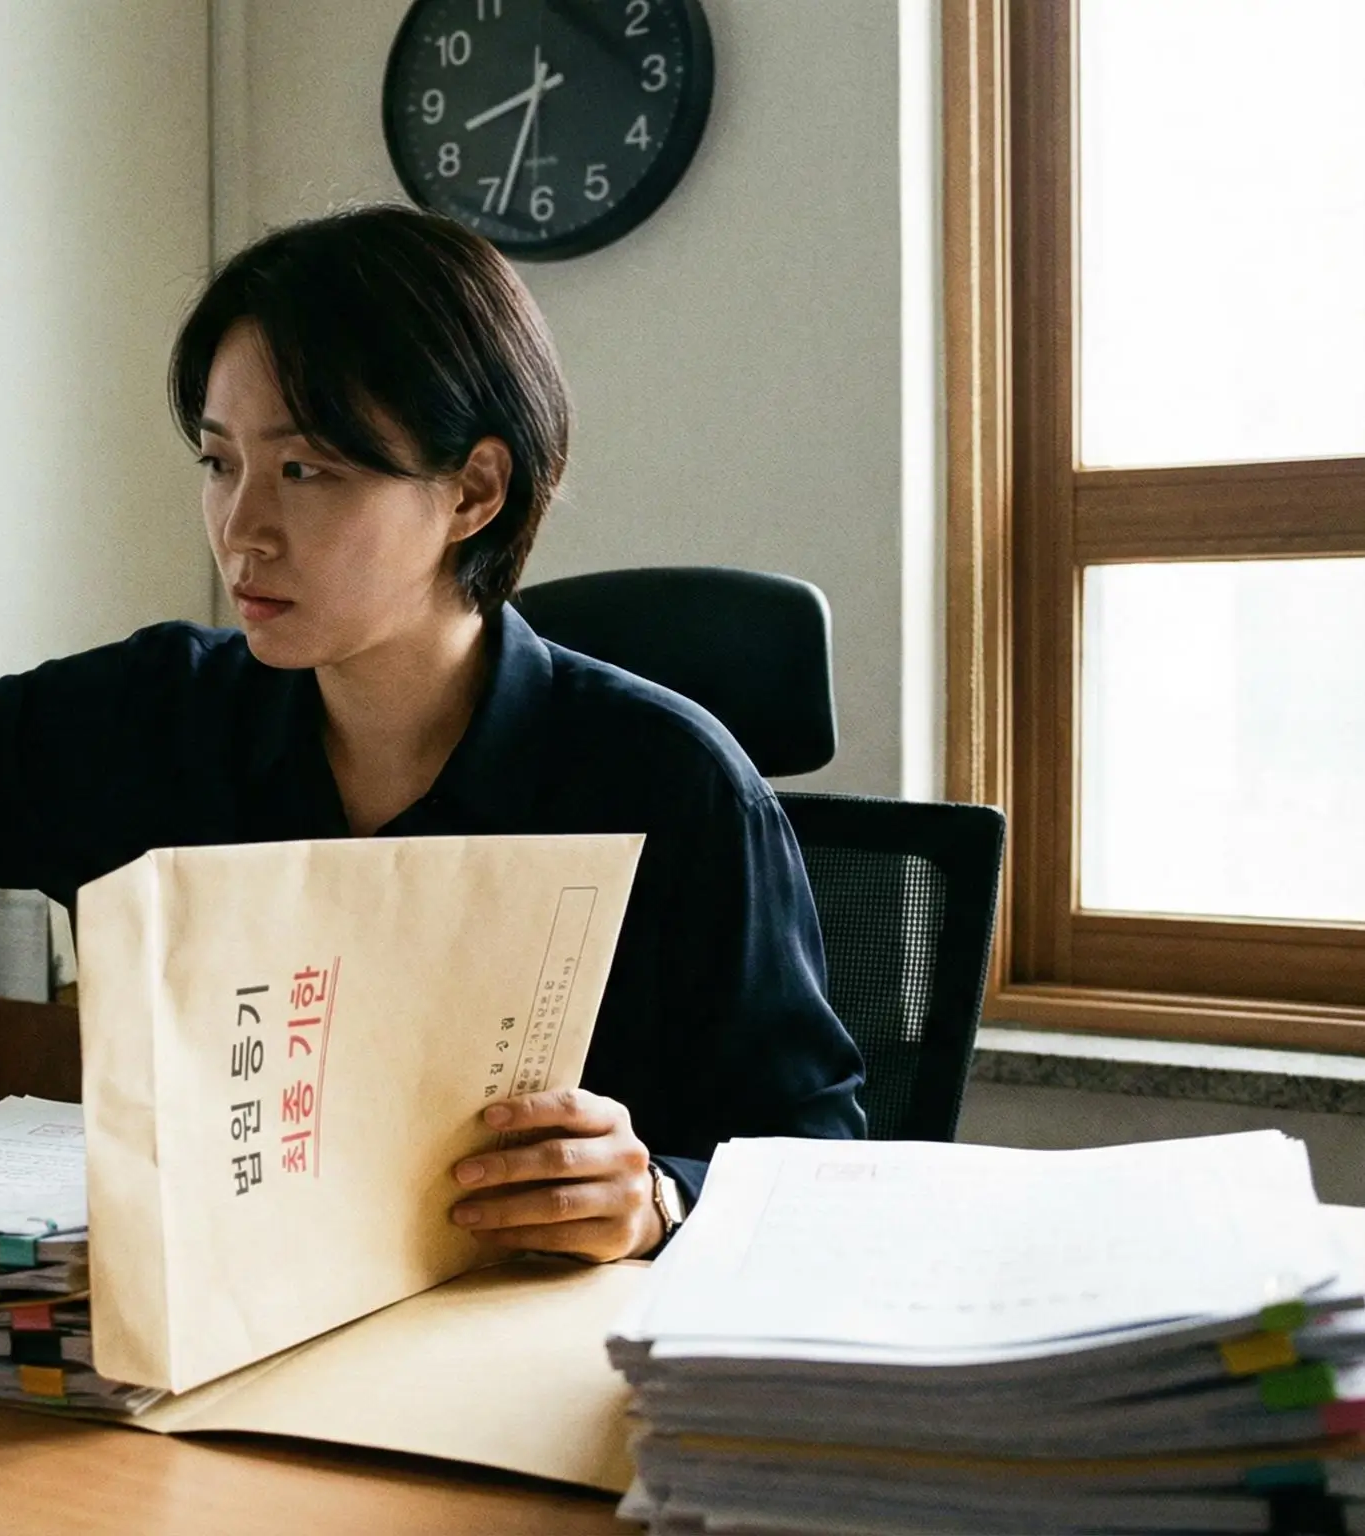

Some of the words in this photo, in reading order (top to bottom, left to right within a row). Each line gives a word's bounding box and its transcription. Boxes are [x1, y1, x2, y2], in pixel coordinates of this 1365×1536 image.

[624, 0, 651, 37] 2
[435, 30, 472, 67] 10
[641, 54, 668, 92] 3
[421, 89, 445, 125] 9
[624, 115, 652, 150] 4
[437, 142, 461, 178] 8
[478, 177, 502, 212] 7
[585, 164, 611, 201] 5
[529, 186, 555, 222] 6
[287, 965, 328, 1059] 기한
[231, 985, 269, 1080] 등기
[281, 1080, 315, 1173] 최종
[231, 1100, 262, 1195] 법원
